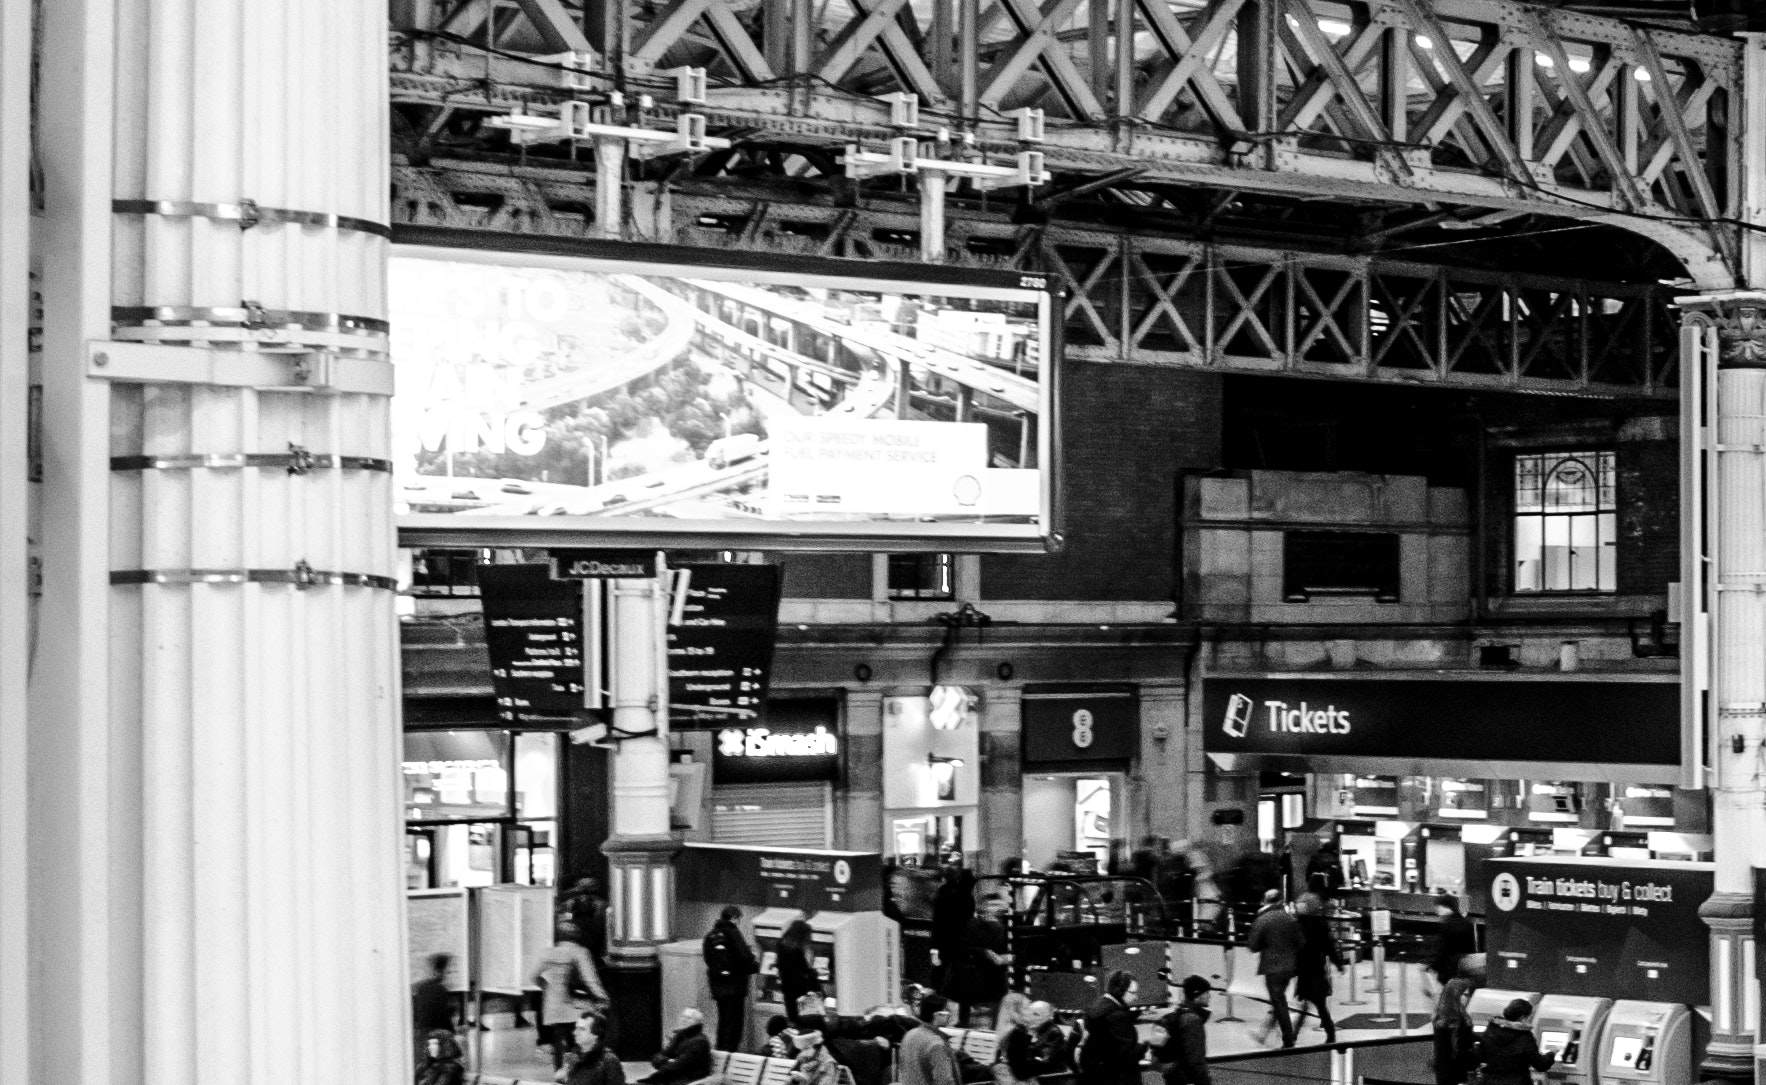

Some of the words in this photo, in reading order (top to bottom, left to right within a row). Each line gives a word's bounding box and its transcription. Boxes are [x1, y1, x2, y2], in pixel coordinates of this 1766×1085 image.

[500, 276, 567, 322] TO
[569, 561, 645, 575] JCDecaux
[1264, 700, 1351, 734] Tickets
[745, 726, 837, 756] iSmash
[1526, 876, 1554, 895] Train
[1556, 878, 1596, 897] tickets
[1598, 880, 1620, 903] buy
[1622, 881, 1632, 900] &
[1633, 882, 1673, 902] collect
